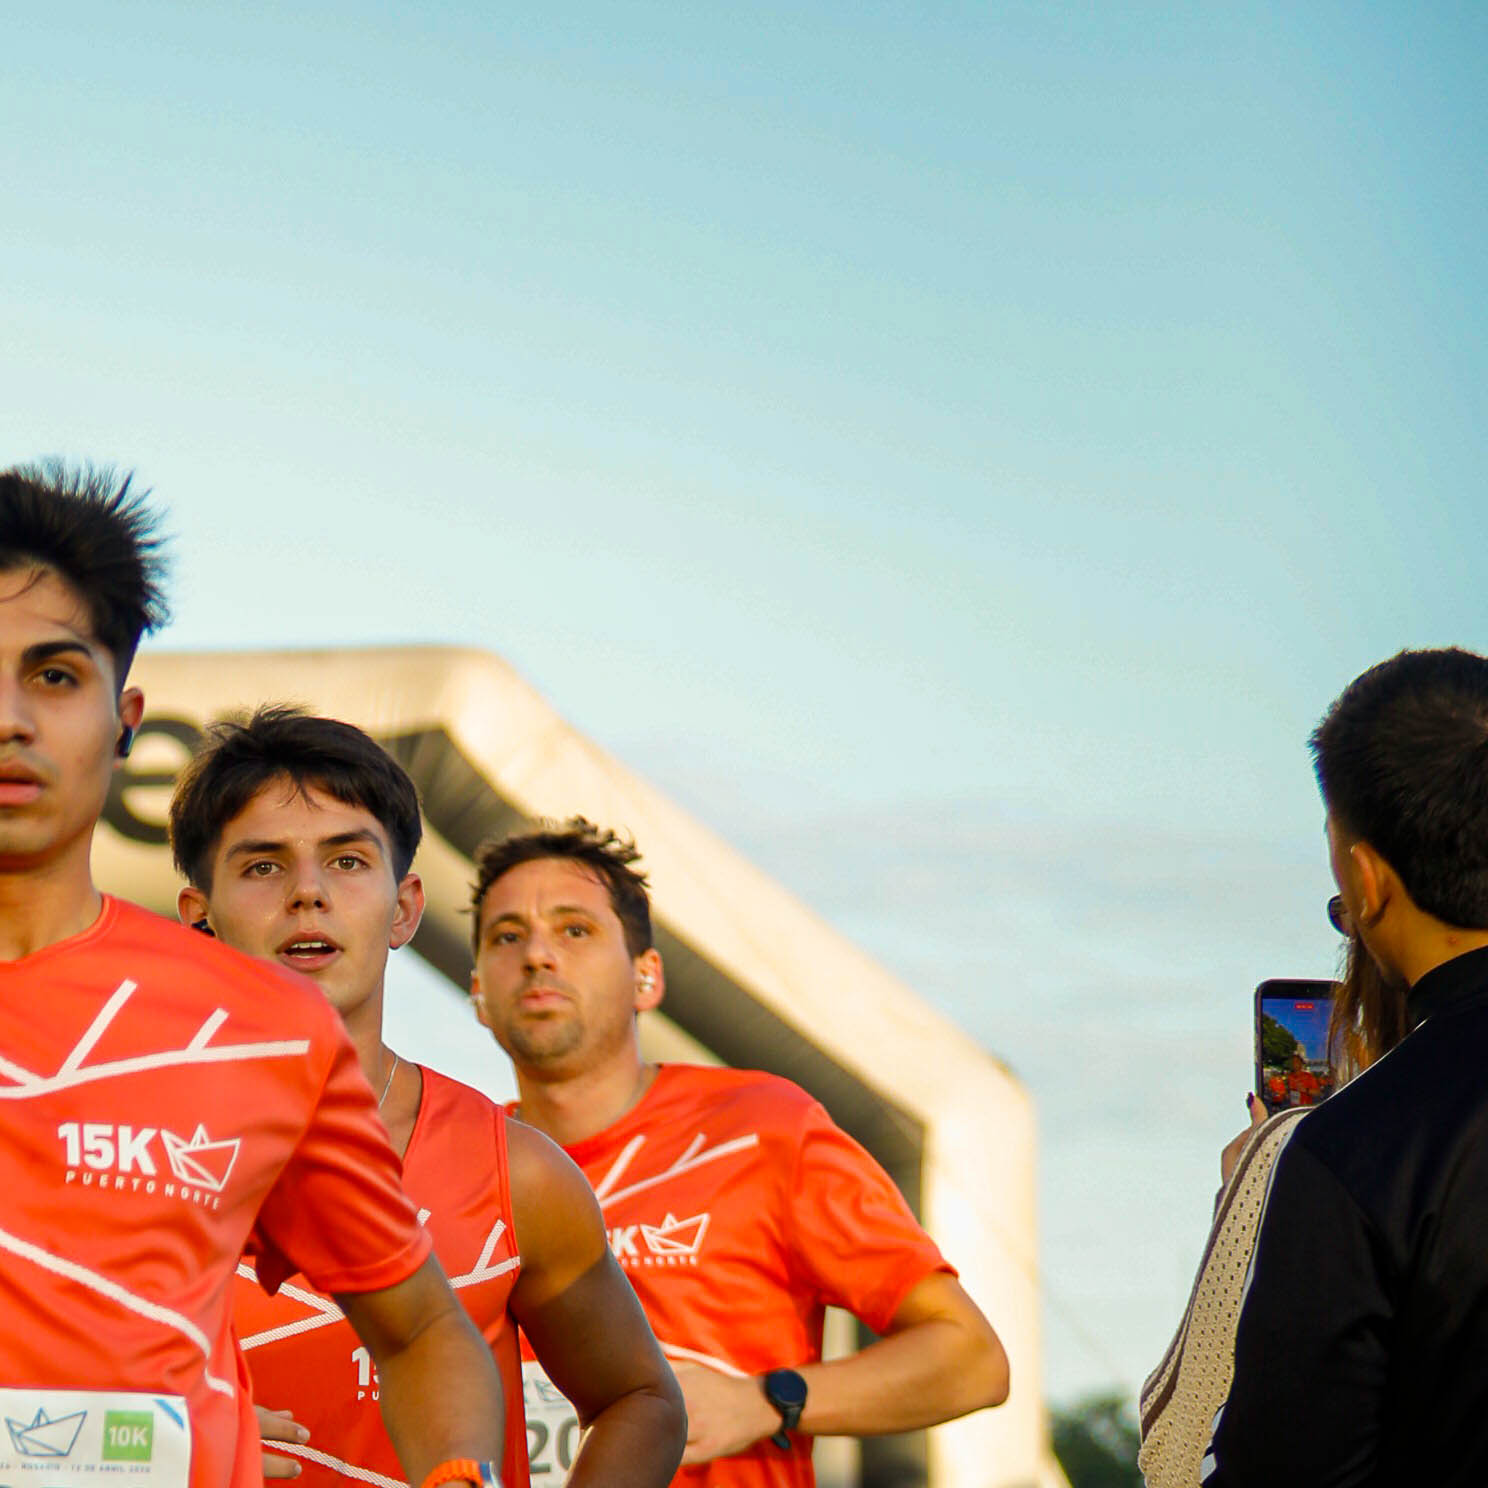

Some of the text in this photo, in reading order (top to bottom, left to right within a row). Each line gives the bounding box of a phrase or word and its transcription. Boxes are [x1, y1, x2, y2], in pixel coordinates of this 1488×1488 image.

[57, 1122, 157, 1176] 15K
[65, 1170, 222, 1210] PUERTO NORTE
[605, 1225, 639, 1257] K
[351, 1346, 379, 1386] 1
[109, 1426, 149, 1447] 10K
